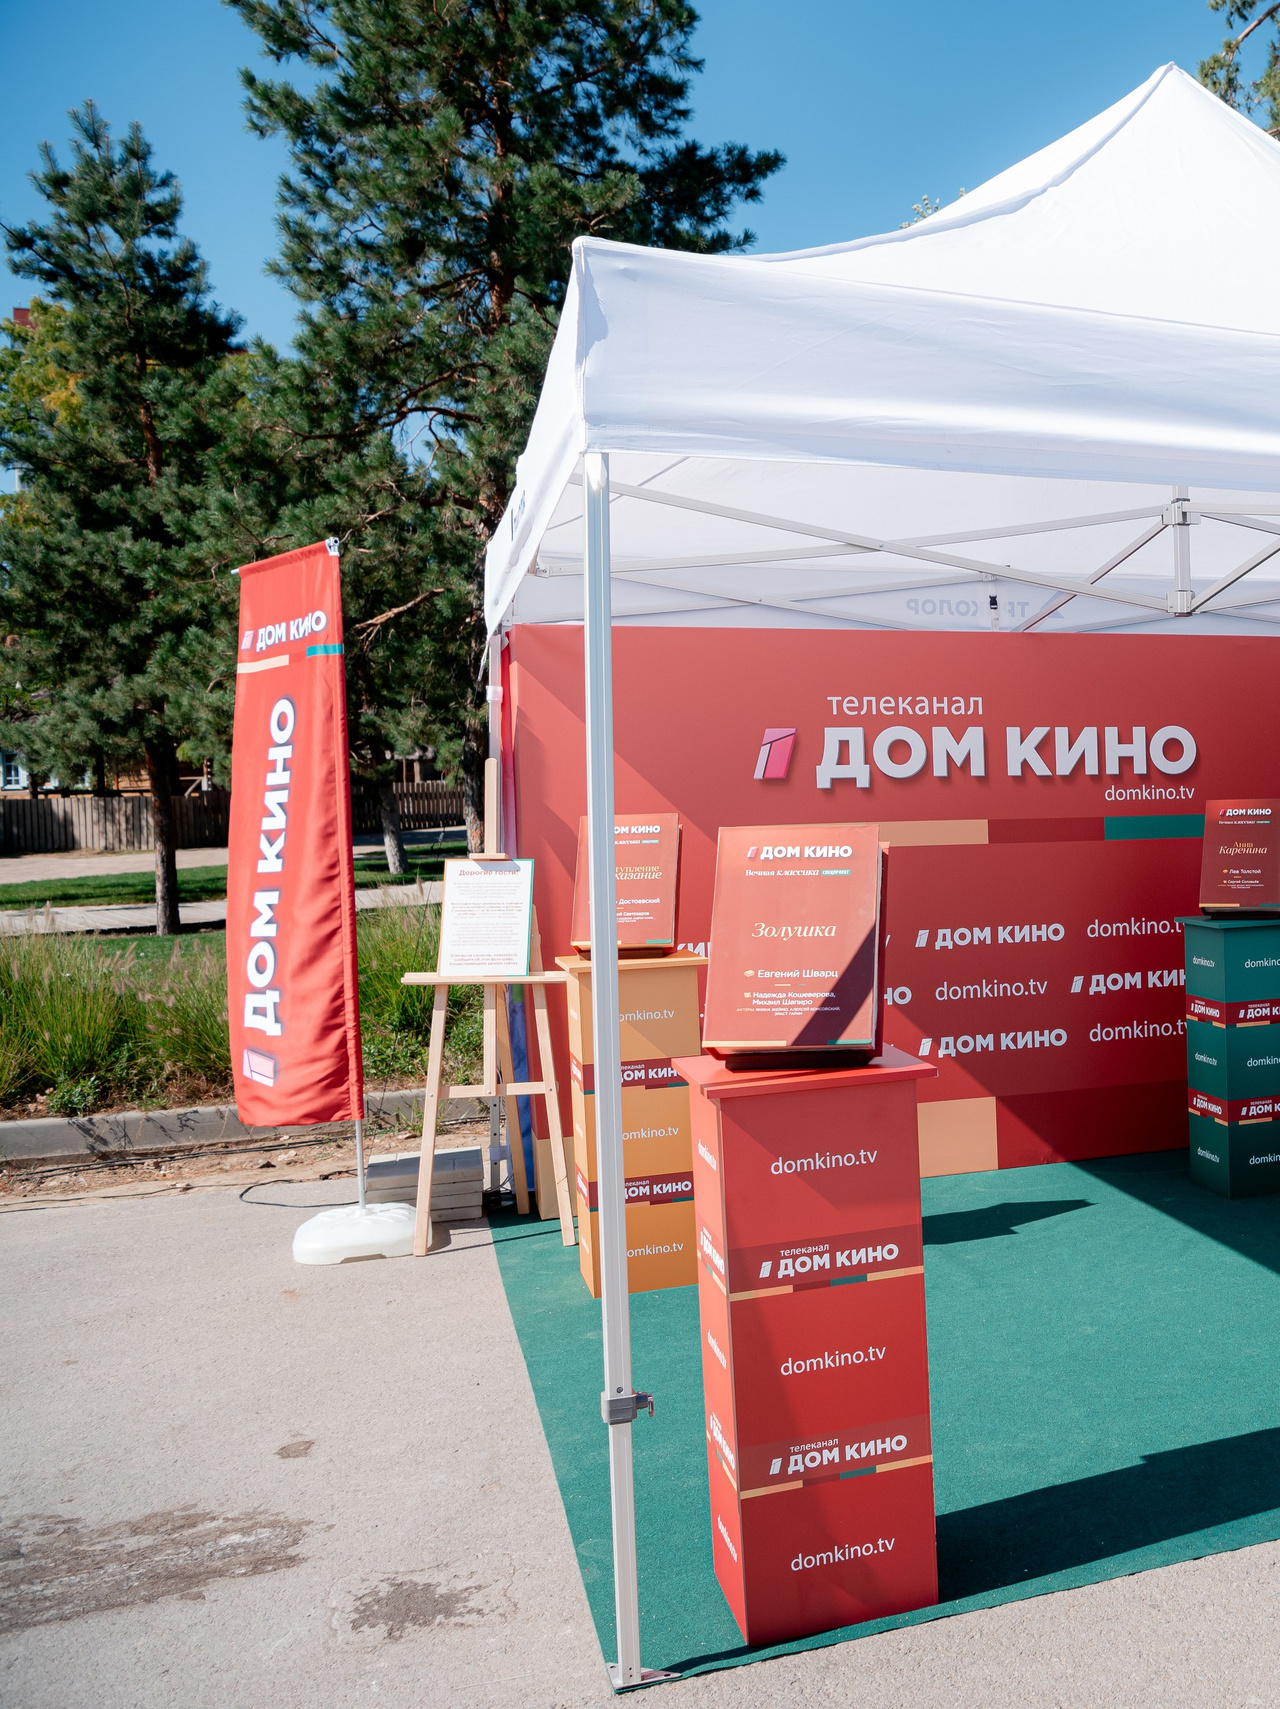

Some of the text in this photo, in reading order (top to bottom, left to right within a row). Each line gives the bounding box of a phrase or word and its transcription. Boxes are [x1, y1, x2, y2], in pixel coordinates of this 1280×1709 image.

[256, 610, 326, 652] ДОМ КИНО
[827, 696, 983, 715] телеканал
[816, 725, 1197, 789] ДОМ КИНО
[1104, 785, 1195, 801] domkino.tv
[1226, 808, 1272, 816] ДОМ КИНО
[614, 825, 660, 834] ОМ КИНО
[760, 846, 852, 860] ДОМ КИНО
[1219, 846, 1268, 856] Каренина
[244, 698, 294, 1036] ДОМ КИНО
[751, 922, 837, 941] Золушка
[935, 923, 1065, 950] ДОМ КИНО
[758, 970, 838, 978] Евгений Шварц
[1089, 972, 1142, 995] ДОМ
[935, 978, 1048, 1000] domkino.tv
[1246, 1008, 1270, 1019] ДОМ
[938, 1028, 1068, 1058] ДОМ КИНО
[1249, 1104, 1272, 1116] ДОМ
[770, 1149, 878, 1175] domkino.tv
[653, 1181, 692, 1194] КИНО
[780, 1244, 830, 1256] телеканал
[777, 1243, 899, 1278] ДОМ КИНО
[780, 1346, 886, 1376] domkino.tv
[787, 1434, 908, 1475] ДОМ КИНО
[790, 1438, 839, 1453] телеканал
[790, 1537, 896, 1572] domkino.tv
